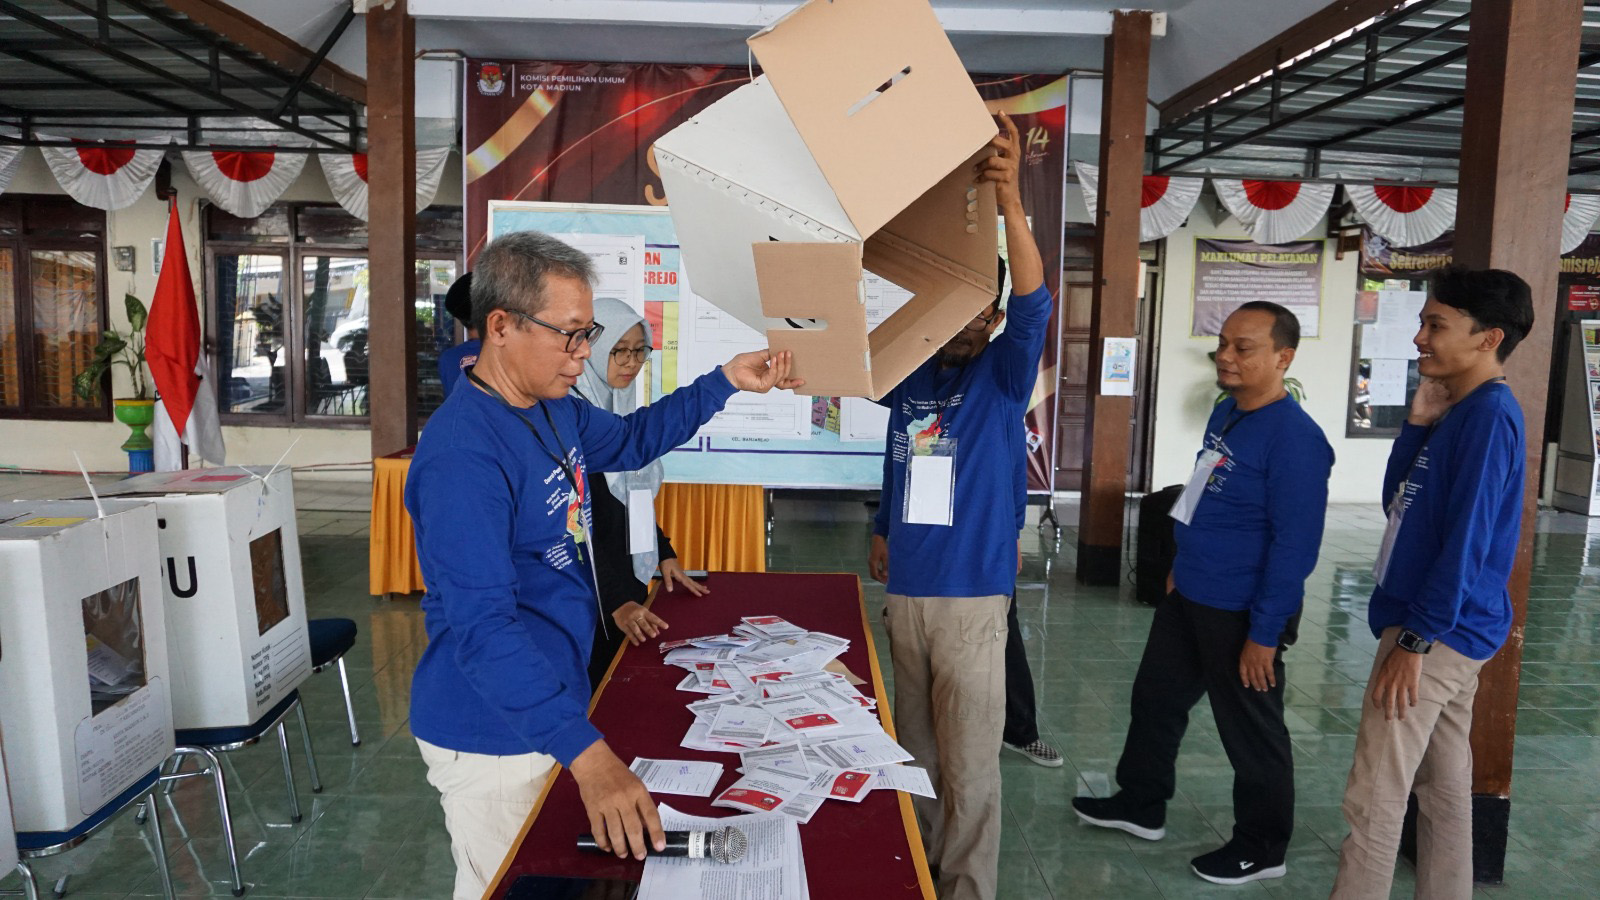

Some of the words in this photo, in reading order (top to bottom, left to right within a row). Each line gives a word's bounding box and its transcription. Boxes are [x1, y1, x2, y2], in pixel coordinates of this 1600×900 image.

[520, 74, 550, 82] KOMISI
[551, 75, 597, 84] PEMILIHAN
[520, 83, 544, 91] KOTA
[1026, 126, 1050, 153] 14
[1200, 252, 1258, 262] MAKLUMAT
[1260, 253, 1318, 264] PELAYANAN
